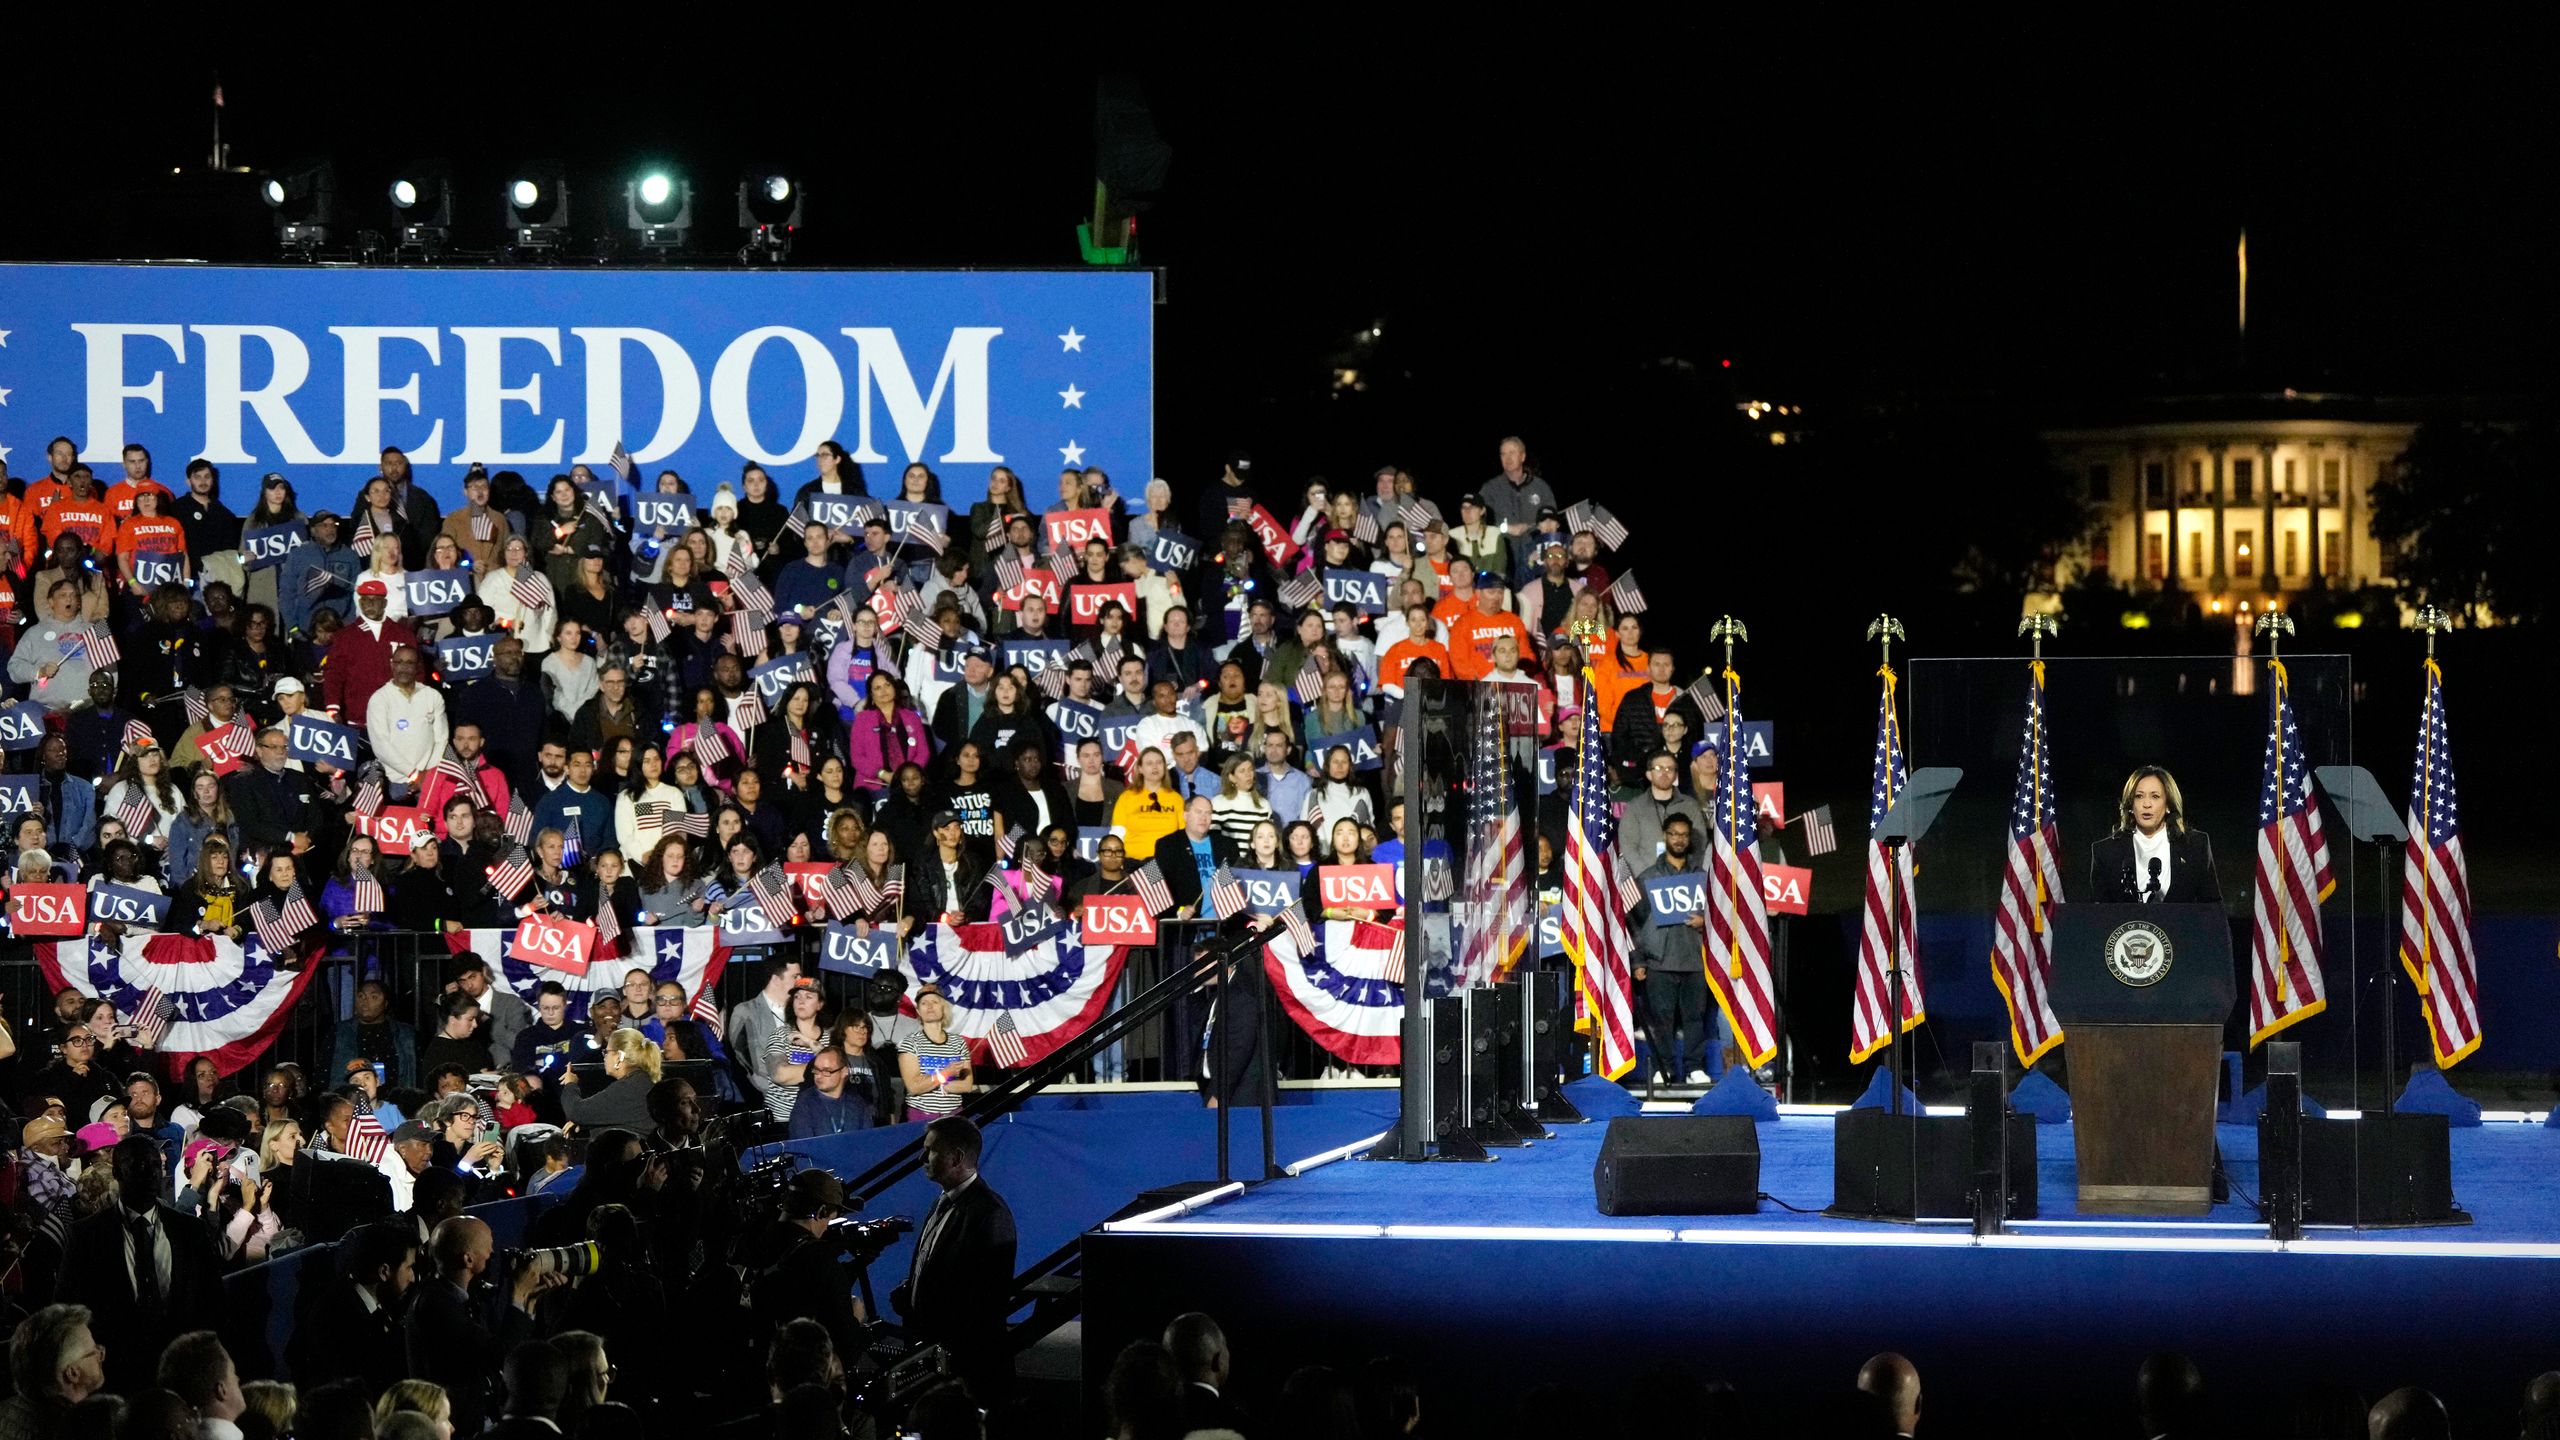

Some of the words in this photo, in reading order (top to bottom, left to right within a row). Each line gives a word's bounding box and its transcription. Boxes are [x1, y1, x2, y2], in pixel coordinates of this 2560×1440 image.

[71, 323, 1004, 466] FREEDOM
[637, 502, 693, 527] USA
[248, 531, 304, 559] USA
[1050, 519, 1108, 547] USA
[1155, 540, 1198, 571] USA
[137, 559, 187, 587] USA
[407, 578, 467, 606] USA
[1326, 577, 1383, 605] USA
[0, 713, 43, 742] SA
[1060, 706, 1099, 735] US
[293, 724, 354, 760] USA
[1105, 726, 1138, 751] US
[0, 786, 33, 812] SA
[359, 815, 418, 844] USA
[1322, 874, 1392, 903] USA
[1762, 874, 1805, 905] SA
[16, 895, 82, 925] USA
[94, 891, 159, 924] USA
[1085, 904, 1152, 934] USA
[1003, 904, 1058, 945] USA
[2138, 923, 2151, 931] THE
[519, 922, 585, 963] USA
[827, 930, 891, 970] USA
[2106, 926, 2126, 966] PRESIDENT
[2152, 927, 2171, 955] UNITED
[2113, 967, 2128, 984] VICE
[2149, 958, 2171, 983] STATES
